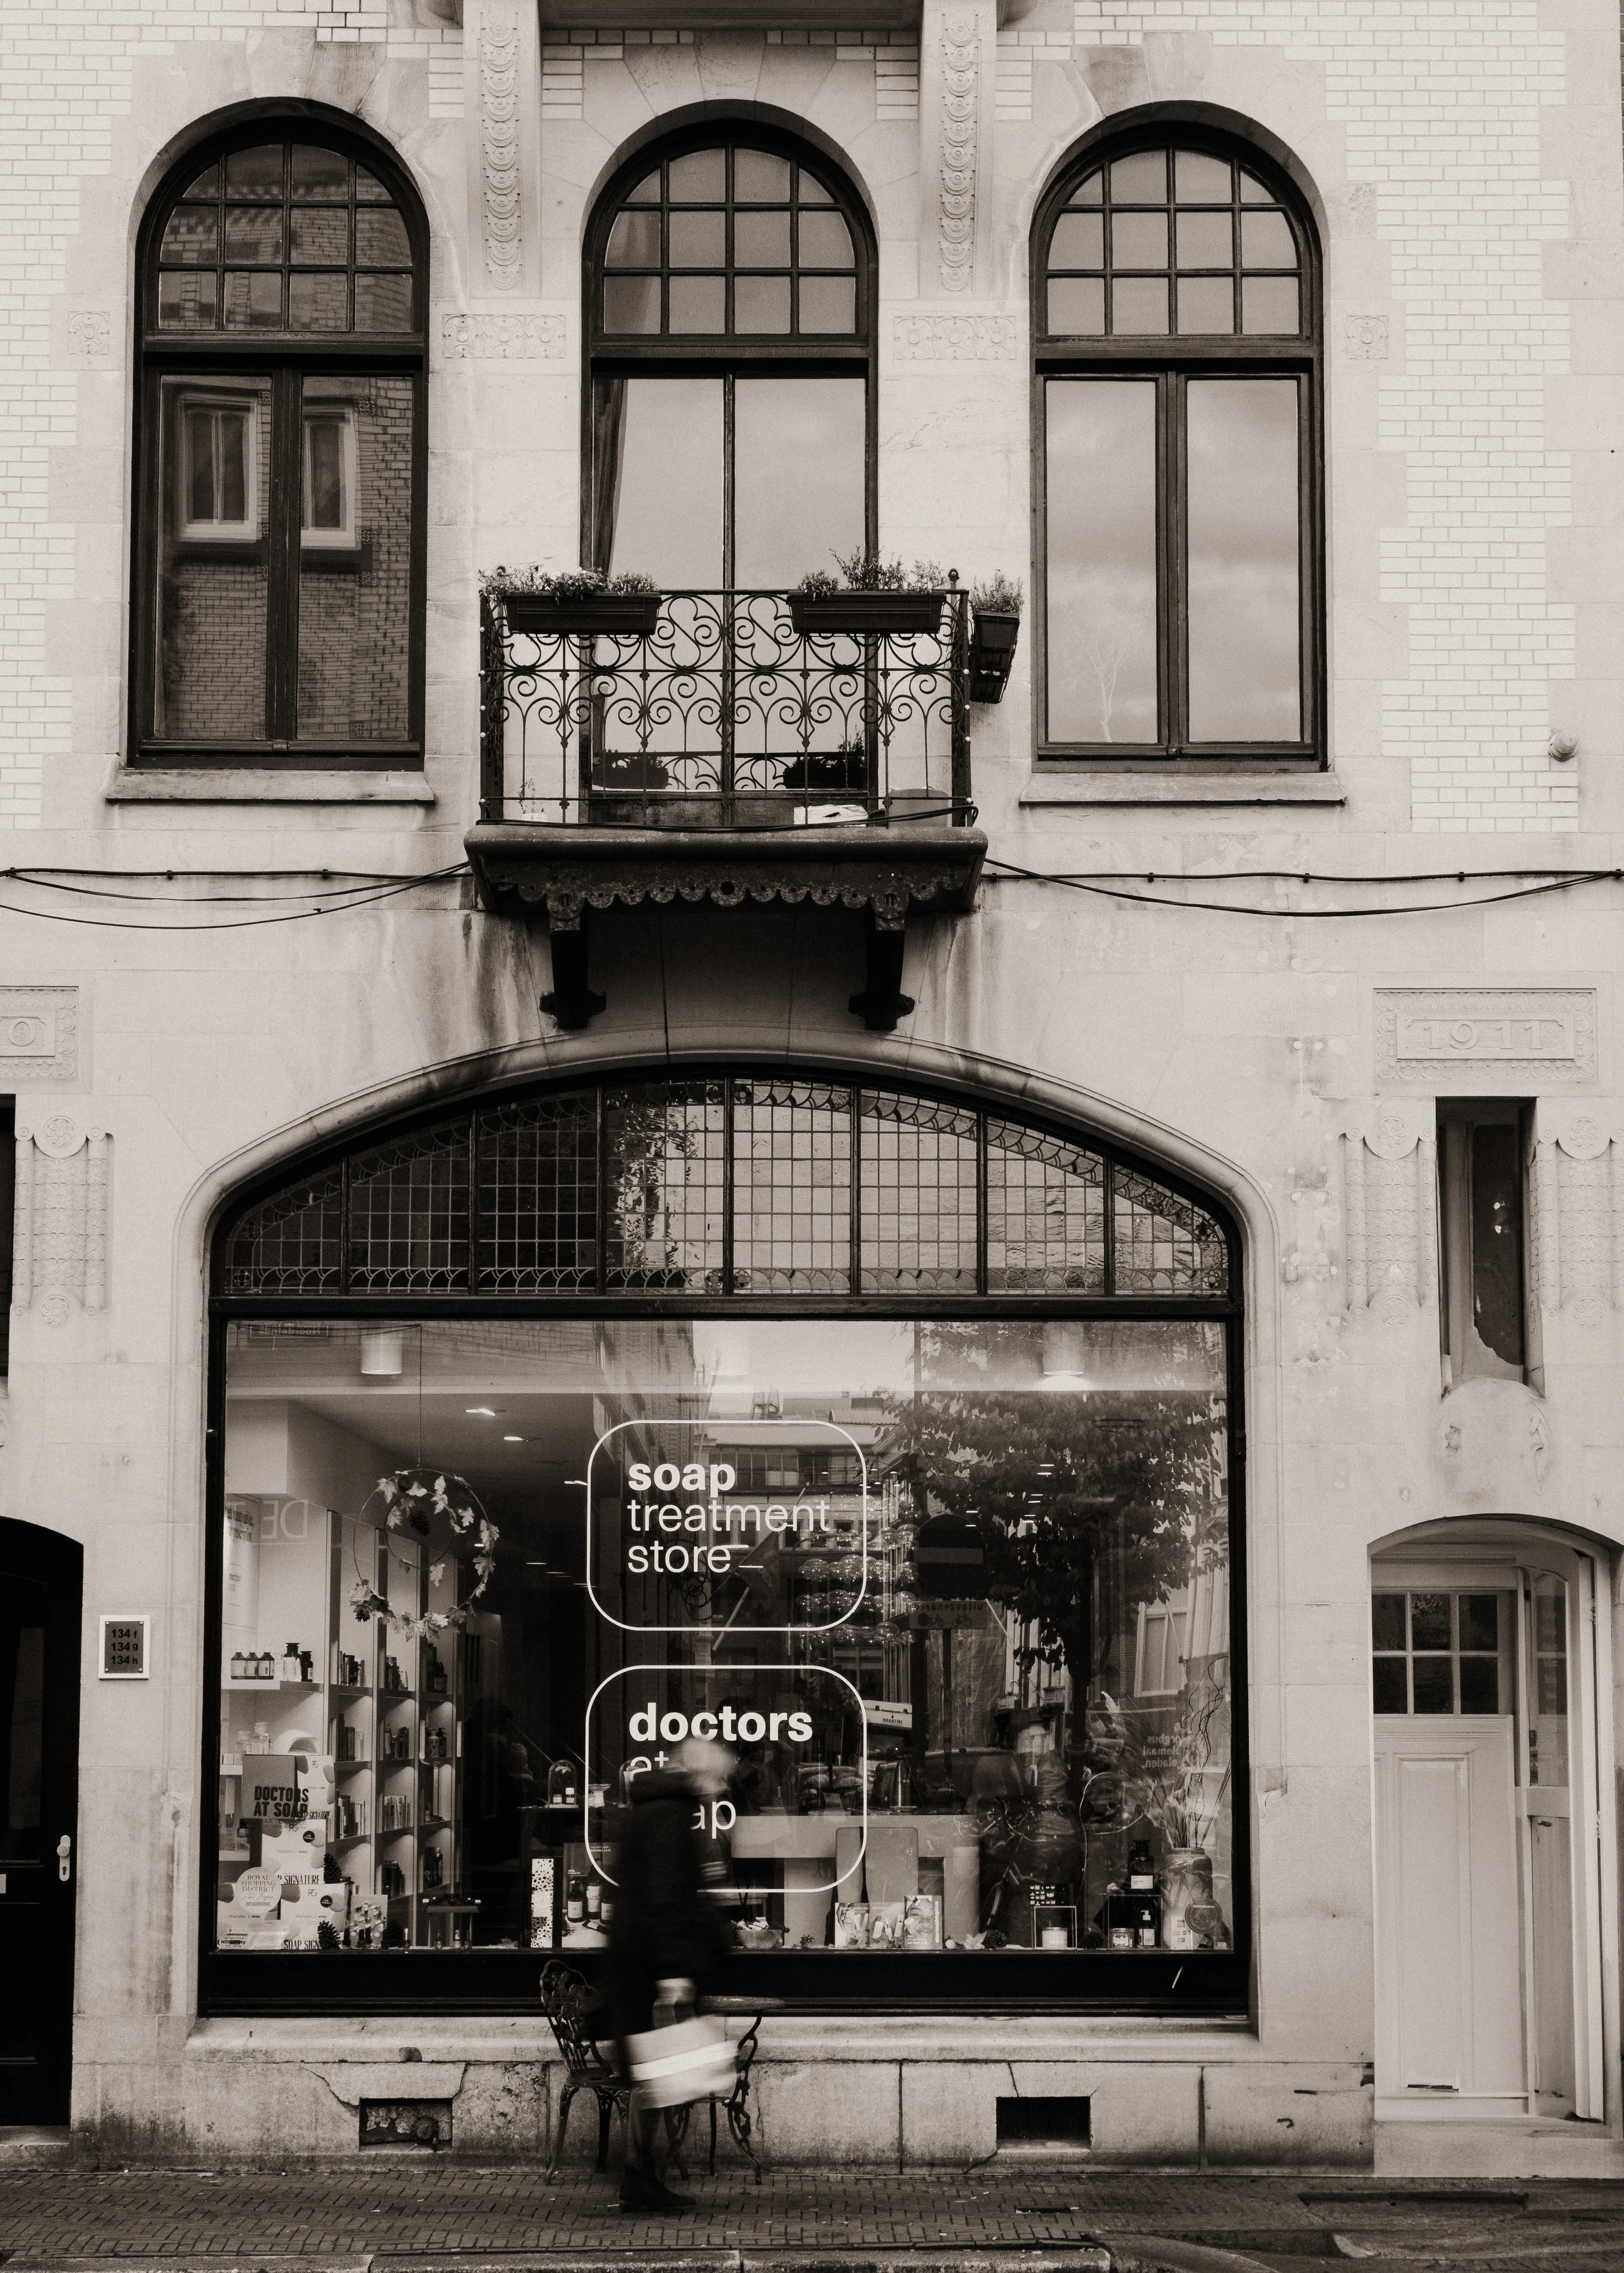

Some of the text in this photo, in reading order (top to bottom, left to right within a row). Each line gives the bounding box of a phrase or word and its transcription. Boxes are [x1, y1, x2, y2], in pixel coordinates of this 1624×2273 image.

[1423, 1020, 1543, 1050] 1911
[628, 1461, 736, 1498] soap
[627, 1499, 830, 1532] treatment
[628, 1540, 731, 1573] store
[111, 1629, 137, 1638] 134 f
[111, 1642, 139, 1652] 134 g
[111, 1655, 138, 1665] 134 h
[629, 1702, 813, 1742] doctors
[254, 1786, 309, 1803] DOCTORS
[253, 1801, 309, 1818] AT SOAP
[691, 1800, 737, 1839] ap
[284, 1875, 321, 1884] SIGNATURE
[284, 1939, 321, 1950] SOAP SIGN
